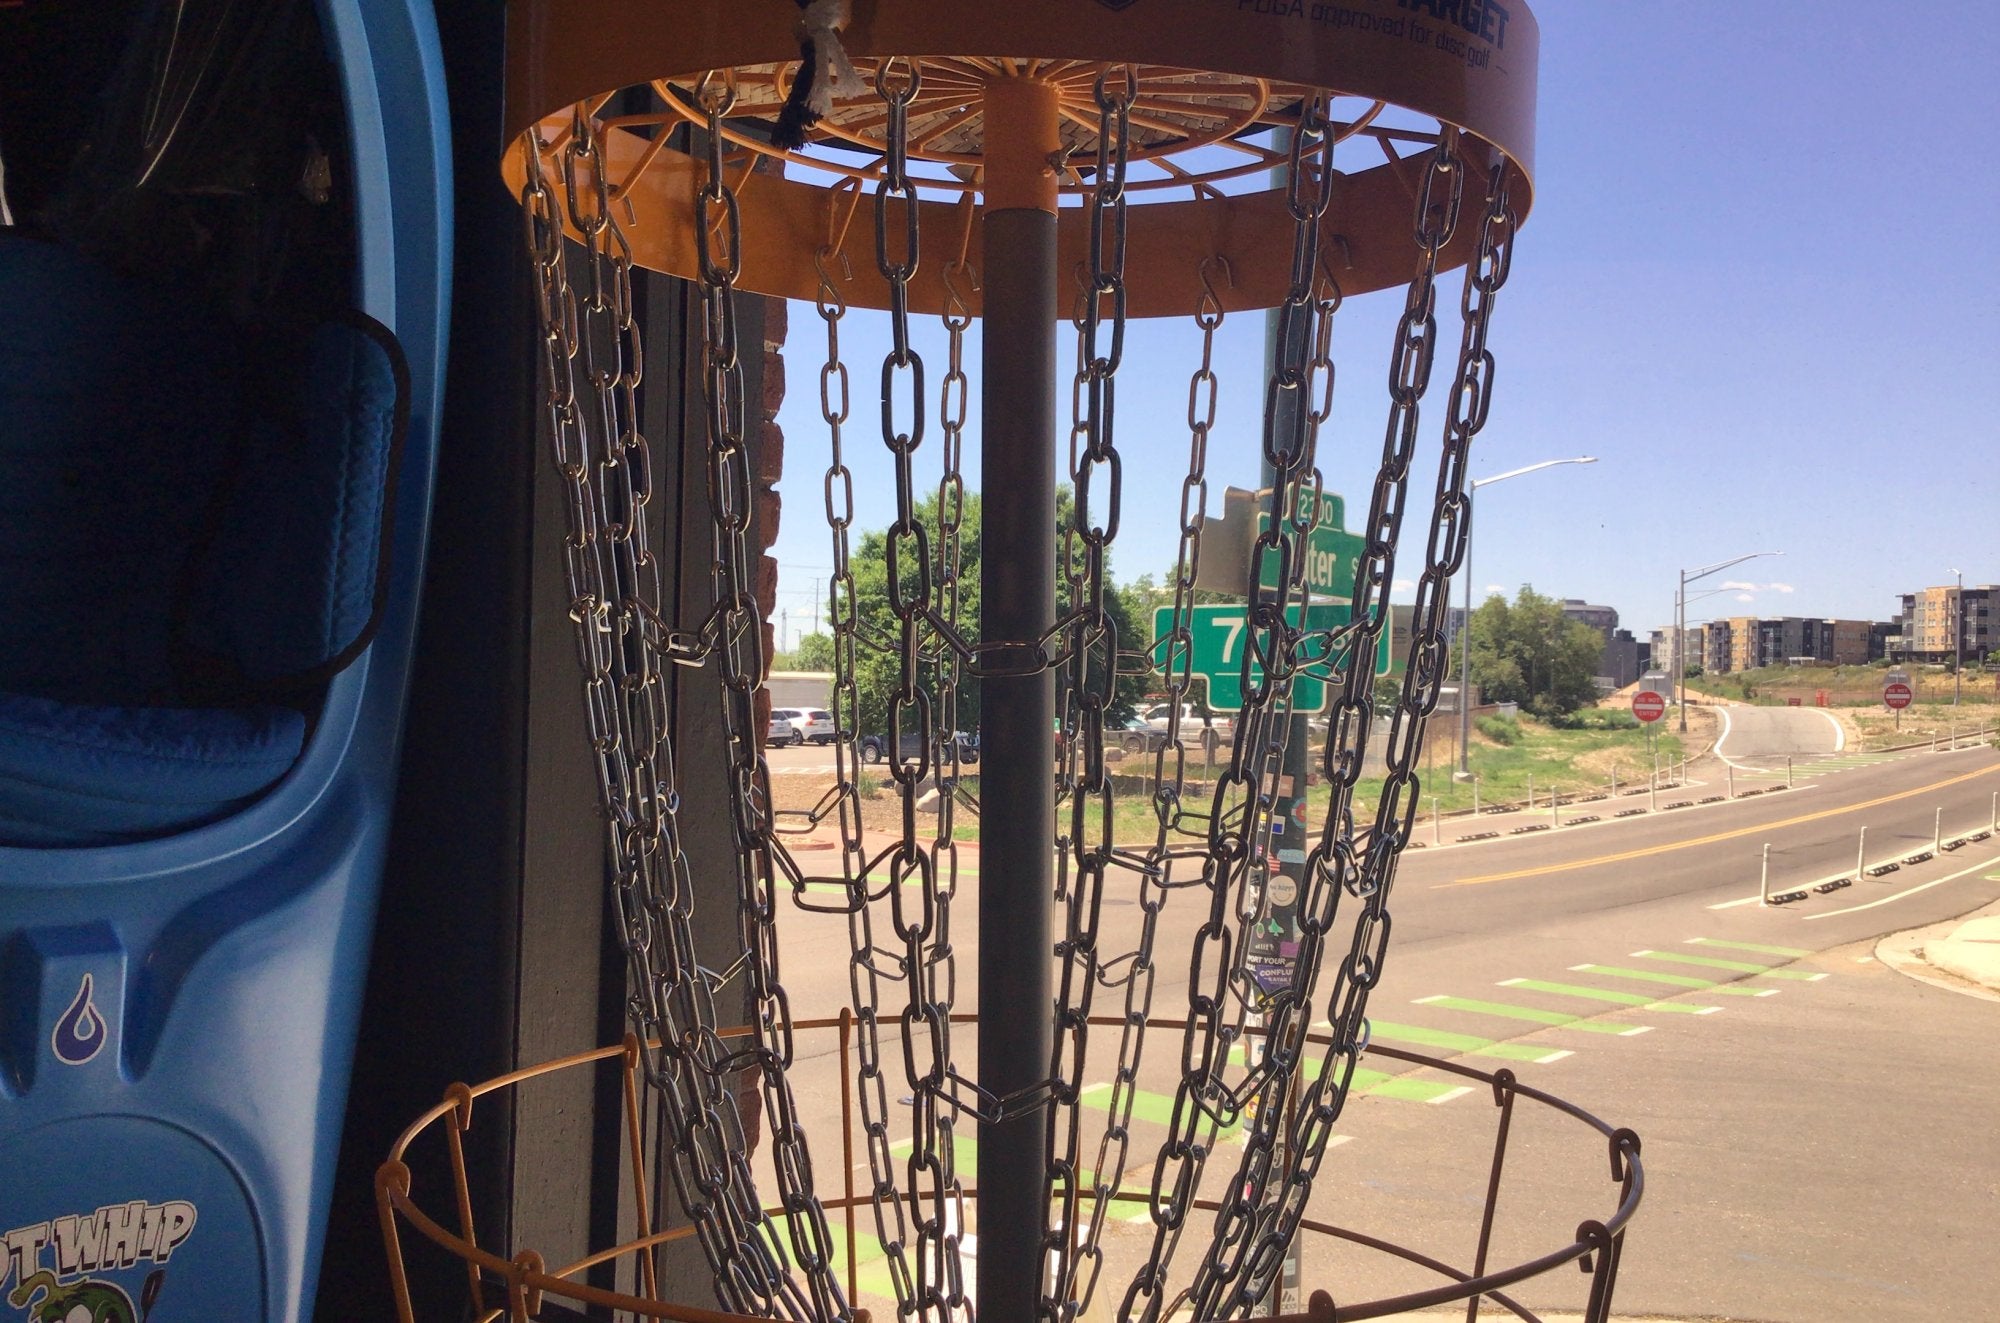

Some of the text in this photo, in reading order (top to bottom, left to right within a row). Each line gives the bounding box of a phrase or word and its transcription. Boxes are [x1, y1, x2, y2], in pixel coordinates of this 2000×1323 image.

[1310, 4, 1405, 37] approved
[1409, 20, 1434, 44] for
[1436, 32, 1465, 58] disc
[1467, 47, 1491, 70] golf
[1398, 0, 1510, 49] RGET
[1259, 969, 1293, 977] CONFLU
[1264, 957, 1286, 965] YOUR
[53, 1201, 195, 1275] WHIP
